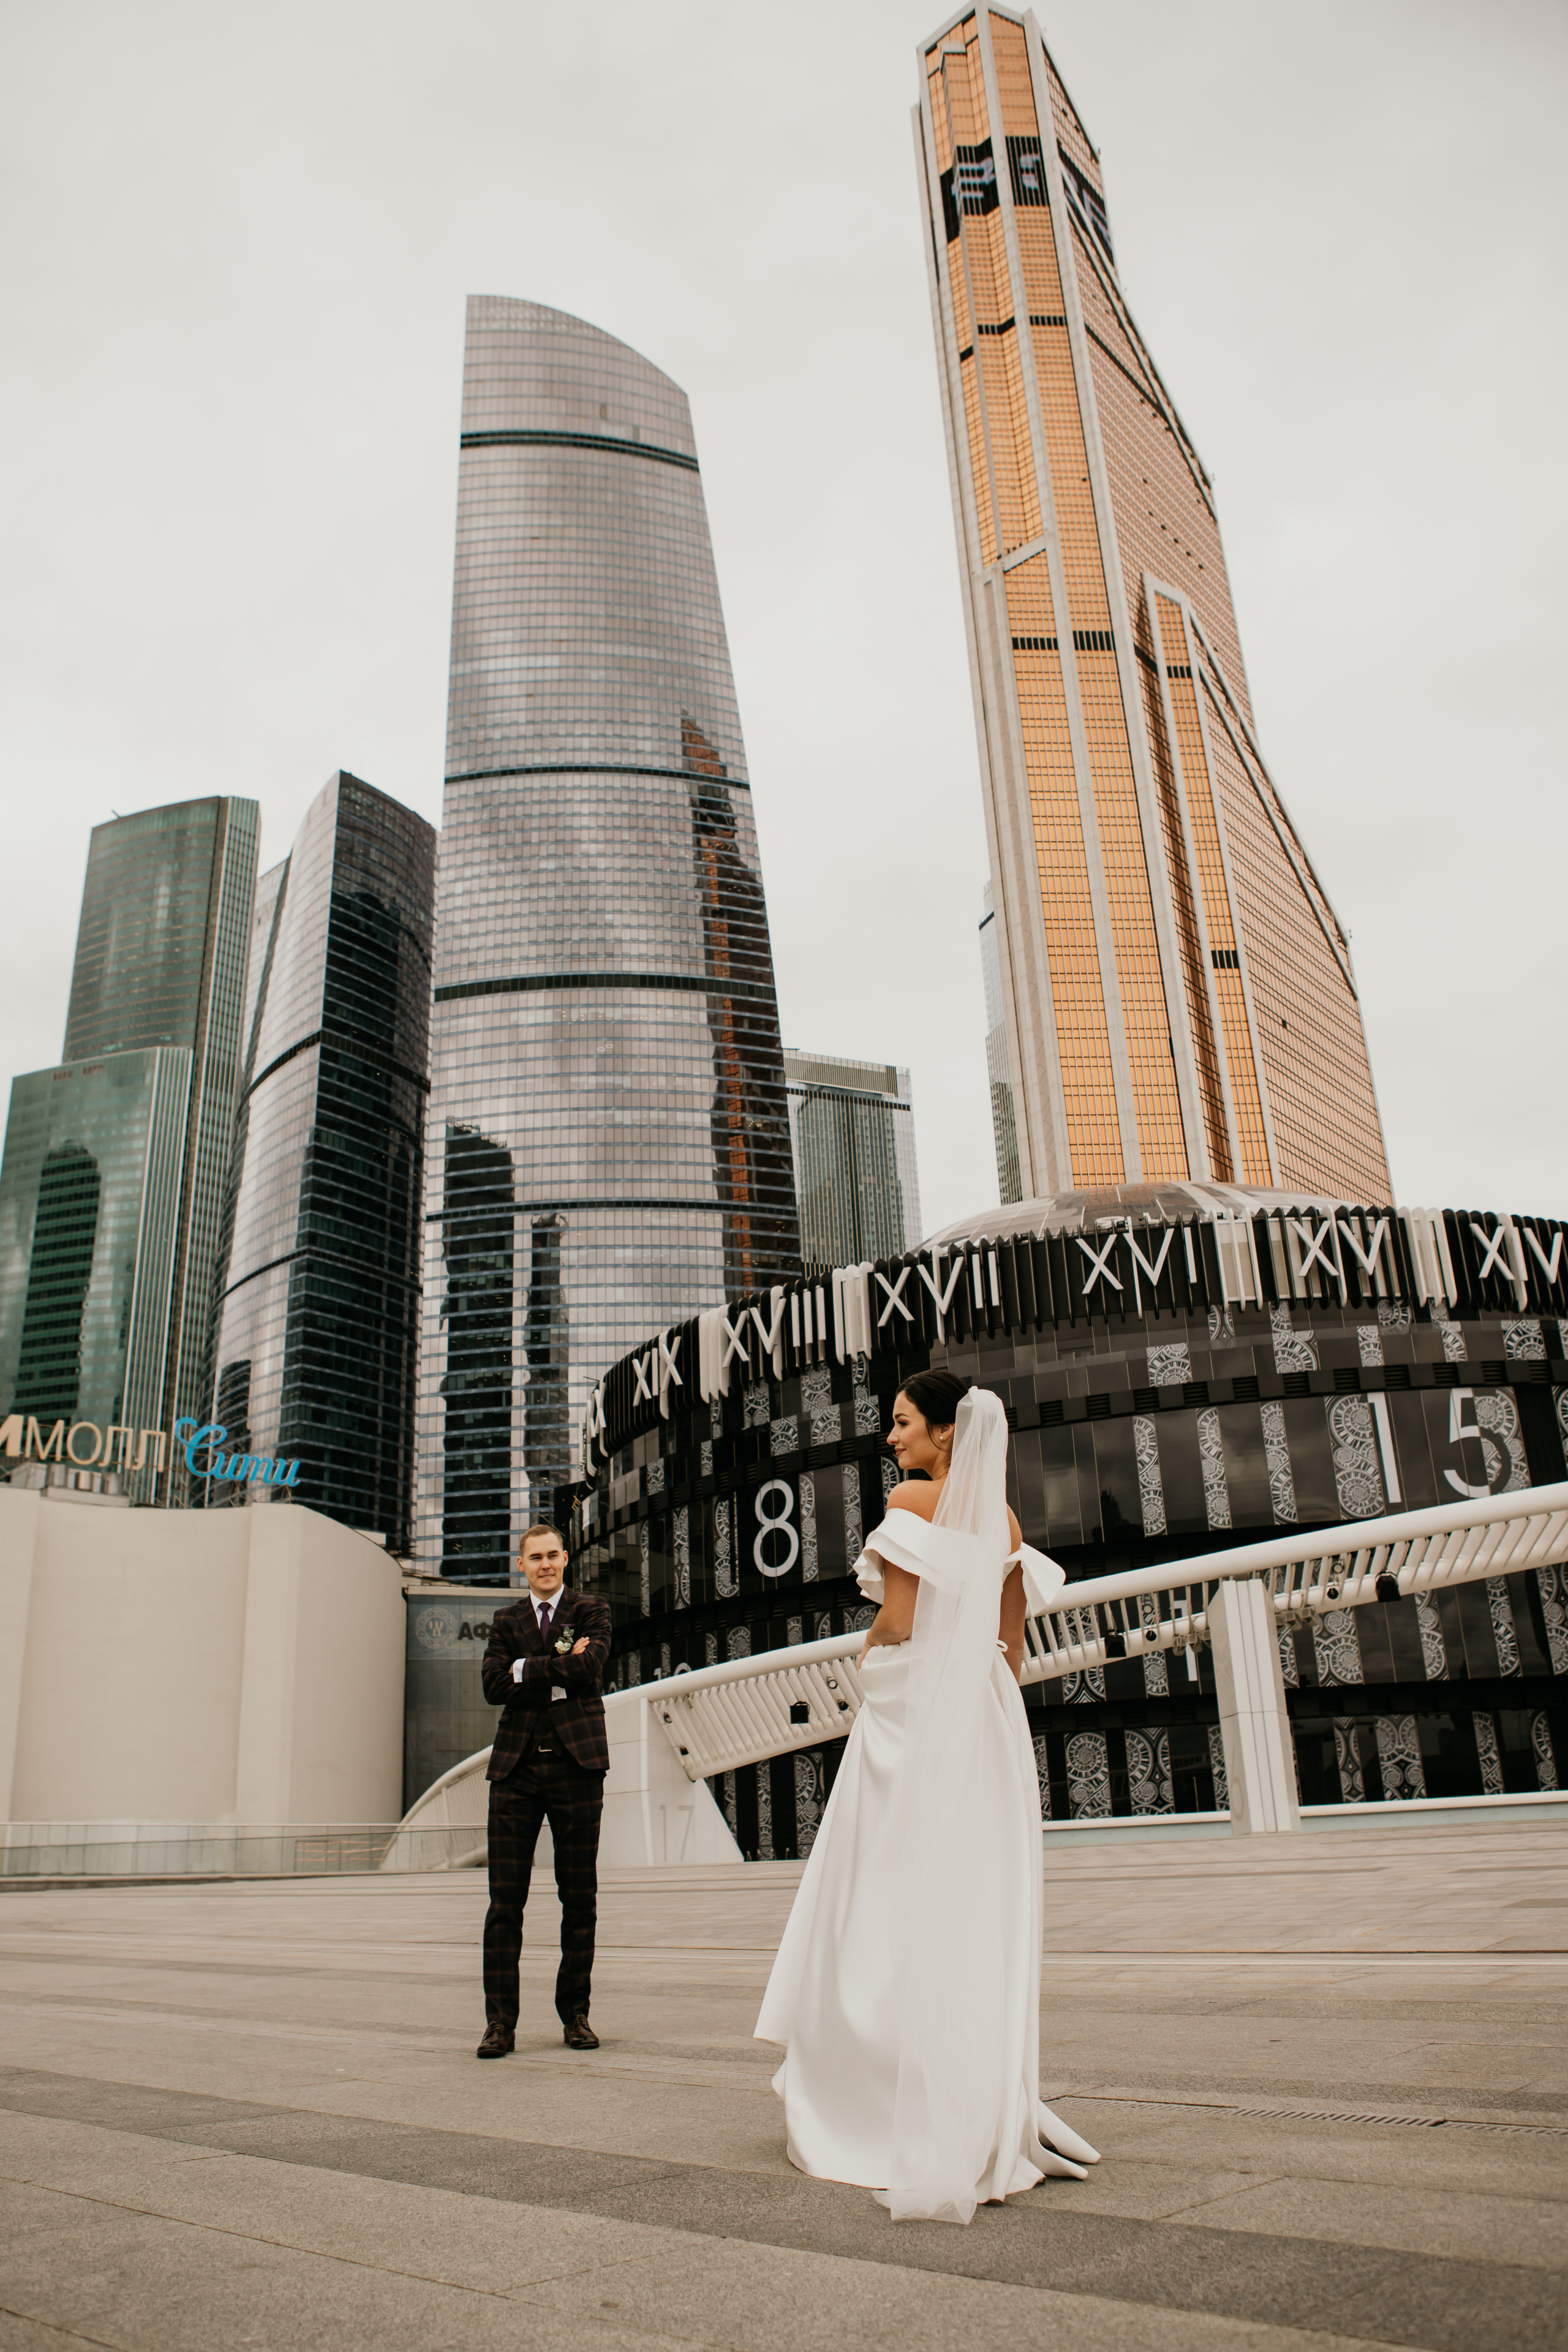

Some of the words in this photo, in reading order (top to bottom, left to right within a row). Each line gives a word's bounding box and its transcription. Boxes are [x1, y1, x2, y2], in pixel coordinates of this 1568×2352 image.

[631, 1335, 684, 1407] XIX
[722, 1286, 827, 1368] XVIII
[873, 1250, 1000, 1327] XVII
[1075, 1226, 1197, 1294] XVI
[1290, 1219, 1386, 1278] XV
[1469, 1223, 1564, 1284] XIV
[174, 1416, 302, 1488] Сити
[1366, 1387, 1512, 1504] 15
[659, 1804, 694, 1862] 17
